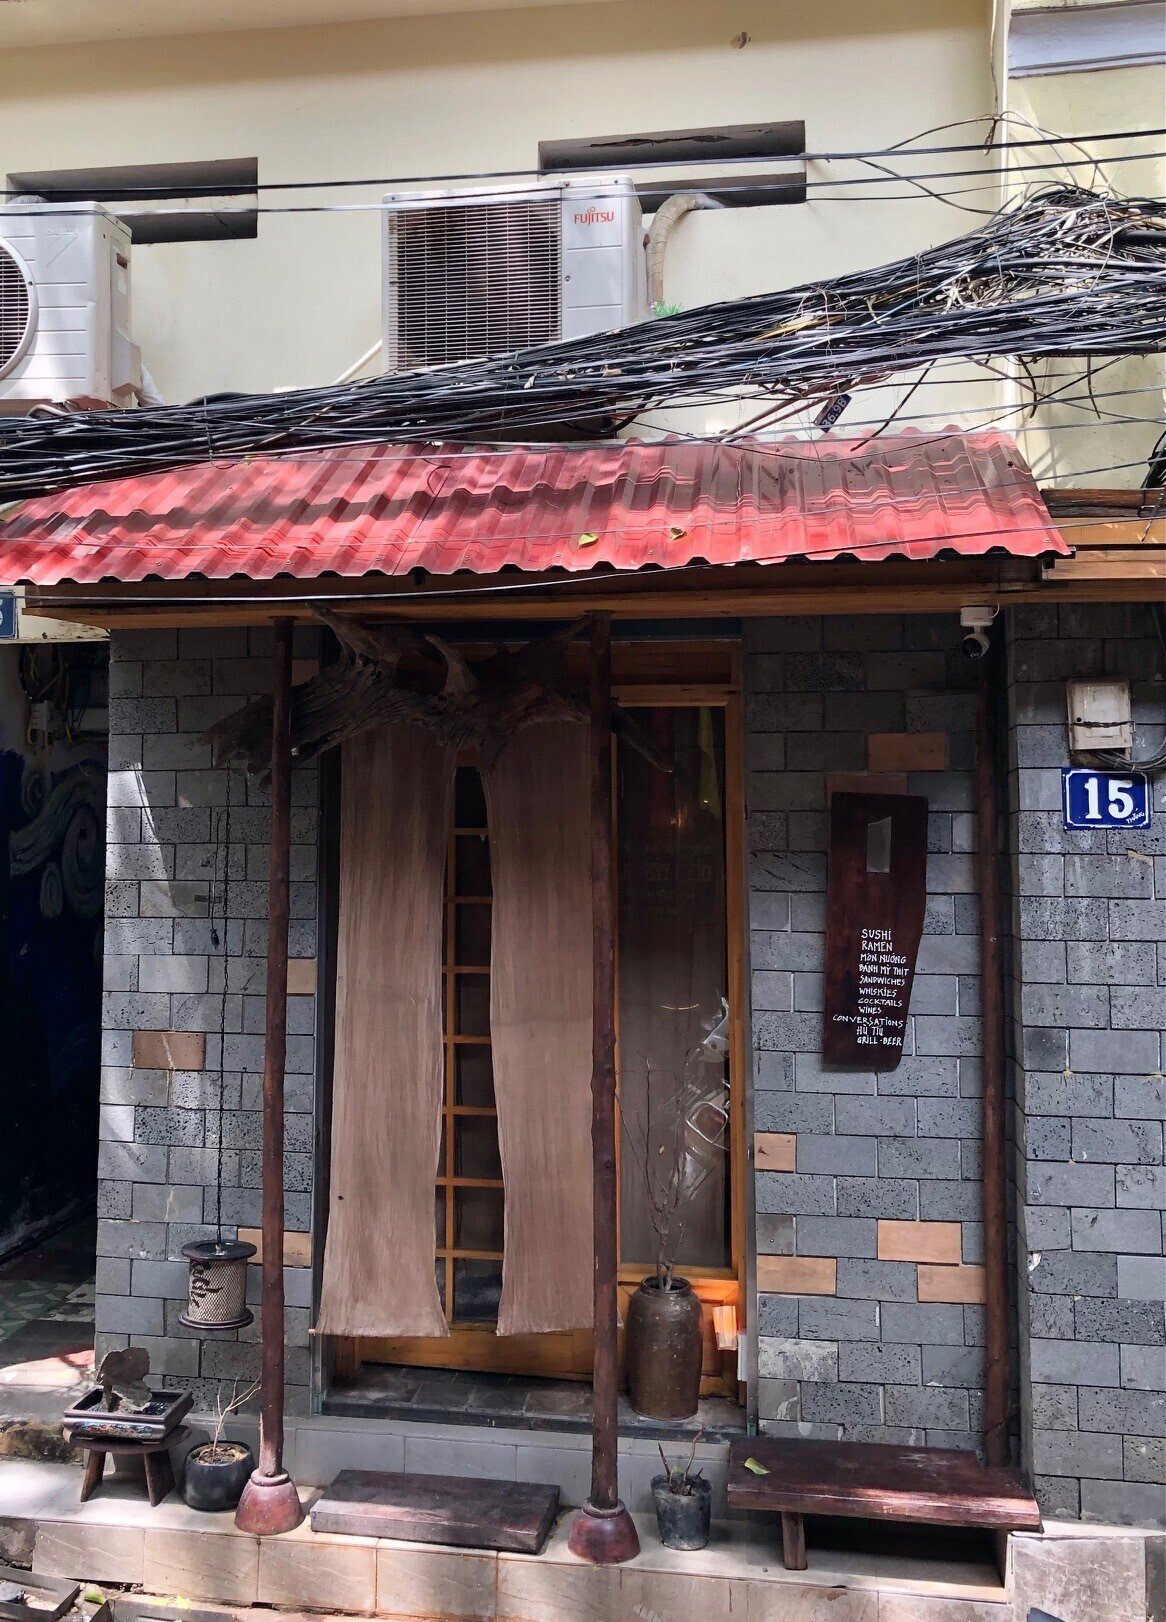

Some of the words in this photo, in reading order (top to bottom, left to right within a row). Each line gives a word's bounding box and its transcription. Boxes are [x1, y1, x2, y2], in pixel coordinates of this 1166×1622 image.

[574, 206, 614, 226] FUJITSU
[1084, 776, 1133, 819] 15
[861, 940, 893, 952] RAMEN
[859, 974, 906, 986] SANDWICHES
[857, 998, 903, 1008] COCKTAILS
